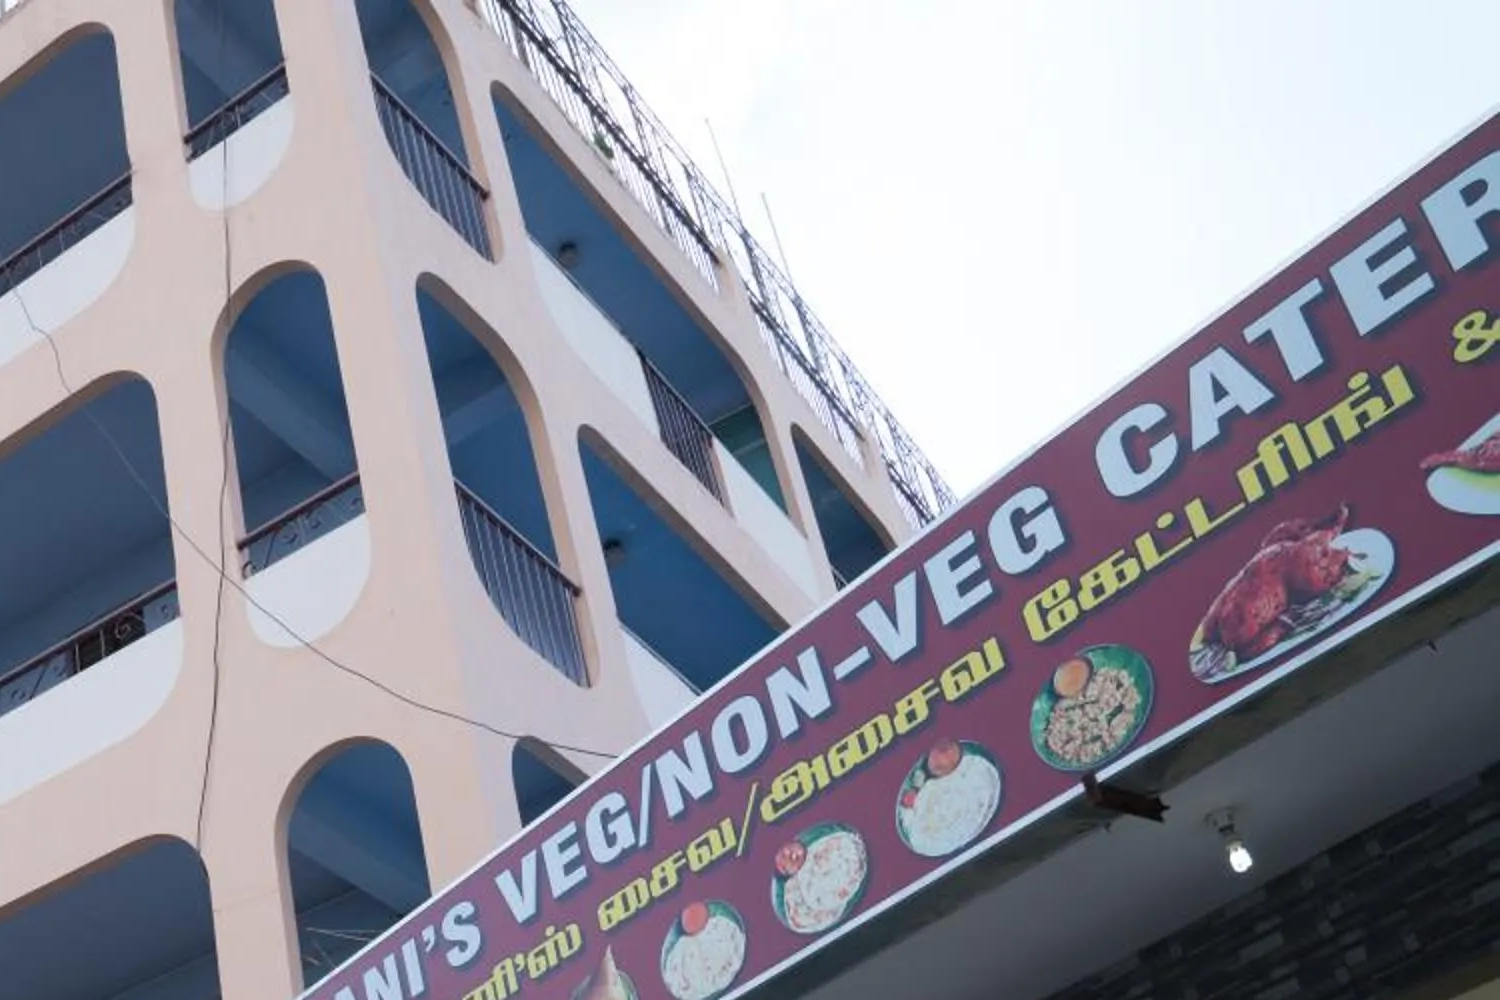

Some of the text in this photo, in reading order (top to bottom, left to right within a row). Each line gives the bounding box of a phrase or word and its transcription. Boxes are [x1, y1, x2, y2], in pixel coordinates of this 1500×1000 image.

[494, 485, 1066, 925] VEG/NON-VEG
[597, 636, 1006, 932] சைவ/அசைவ
[1022, 364, 1416, 642] கேட்டரிங்
[1452, 309, 1500, 363] &
